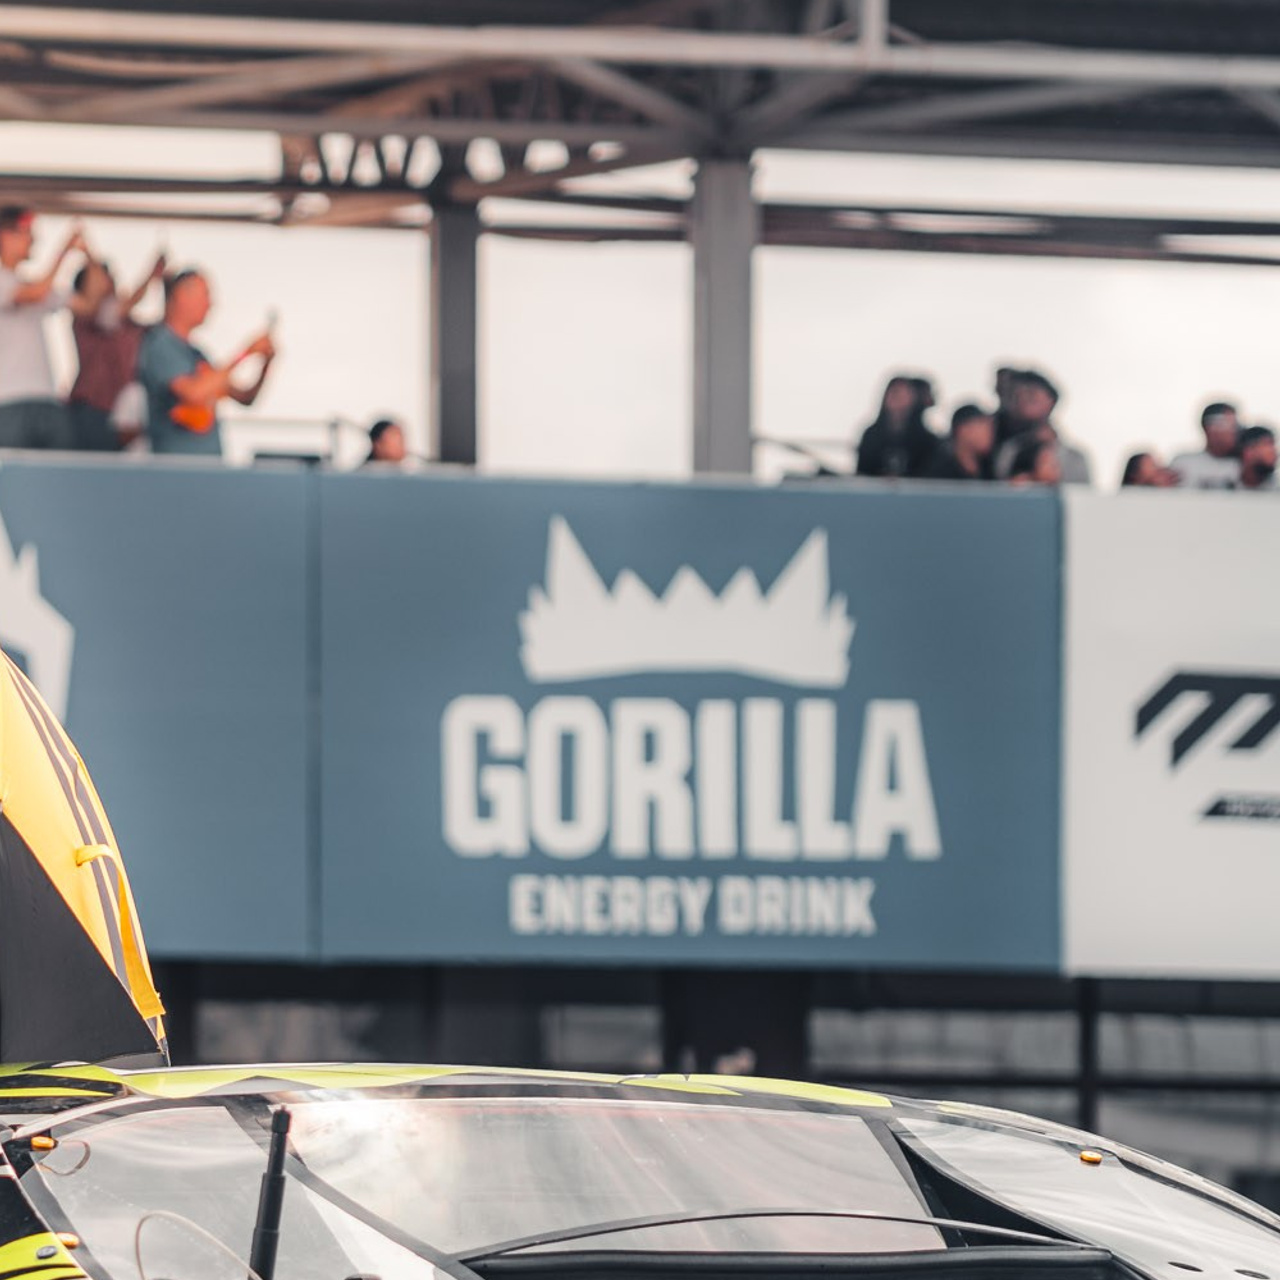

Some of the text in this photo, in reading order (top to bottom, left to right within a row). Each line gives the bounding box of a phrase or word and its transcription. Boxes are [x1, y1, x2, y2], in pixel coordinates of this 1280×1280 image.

[440, 694, 942, 861] GORILLA
[510, 874, 876, 937] ENERGY DRINK
